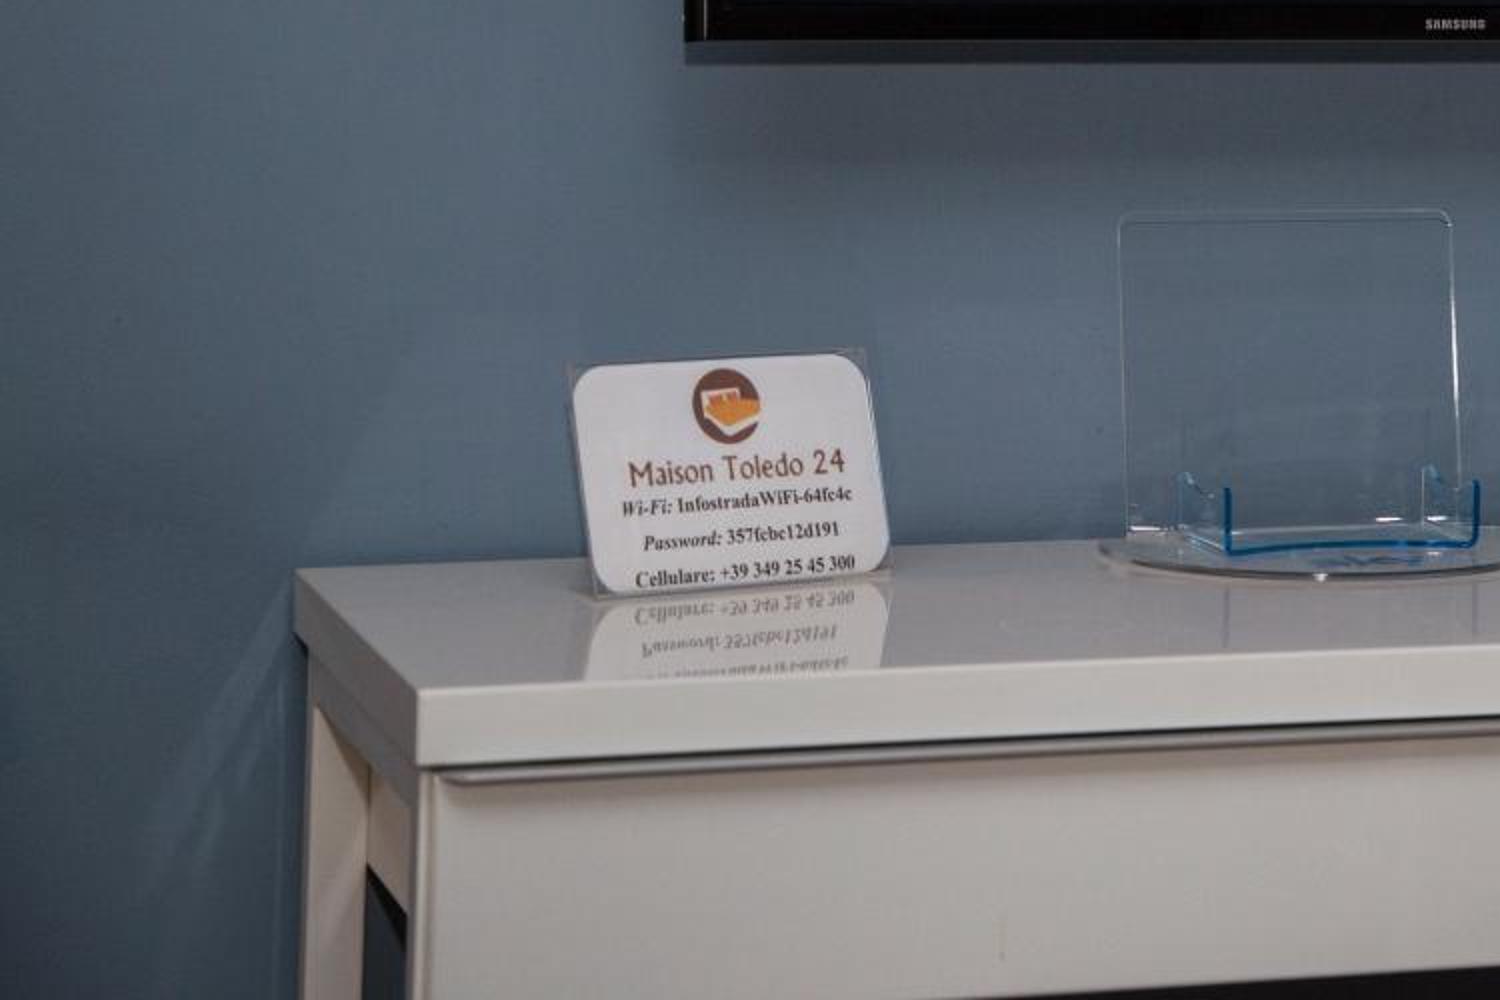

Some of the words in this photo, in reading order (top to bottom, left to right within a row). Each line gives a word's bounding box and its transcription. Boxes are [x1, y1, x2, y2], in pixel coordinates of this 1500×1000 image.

[1424, 18, 1487, 31] SAMSUNG
[627, 460, 714, 489] Maison
[721, 452, 804, 481] Toledo
[813, 449, 846, 475] 24
[622, 498, 672, 518] Wi-Fi:
[643, 529, 723, 552] Password:
[635, 567, 716, 589] Cellulare:
[719, 563, 749, 581] +39
[753, 560, 780, 578] 349
[784, 558, 803, 575] 25
[807, 556, 826, 573] 45
[829, 554, 856, 571] 300
